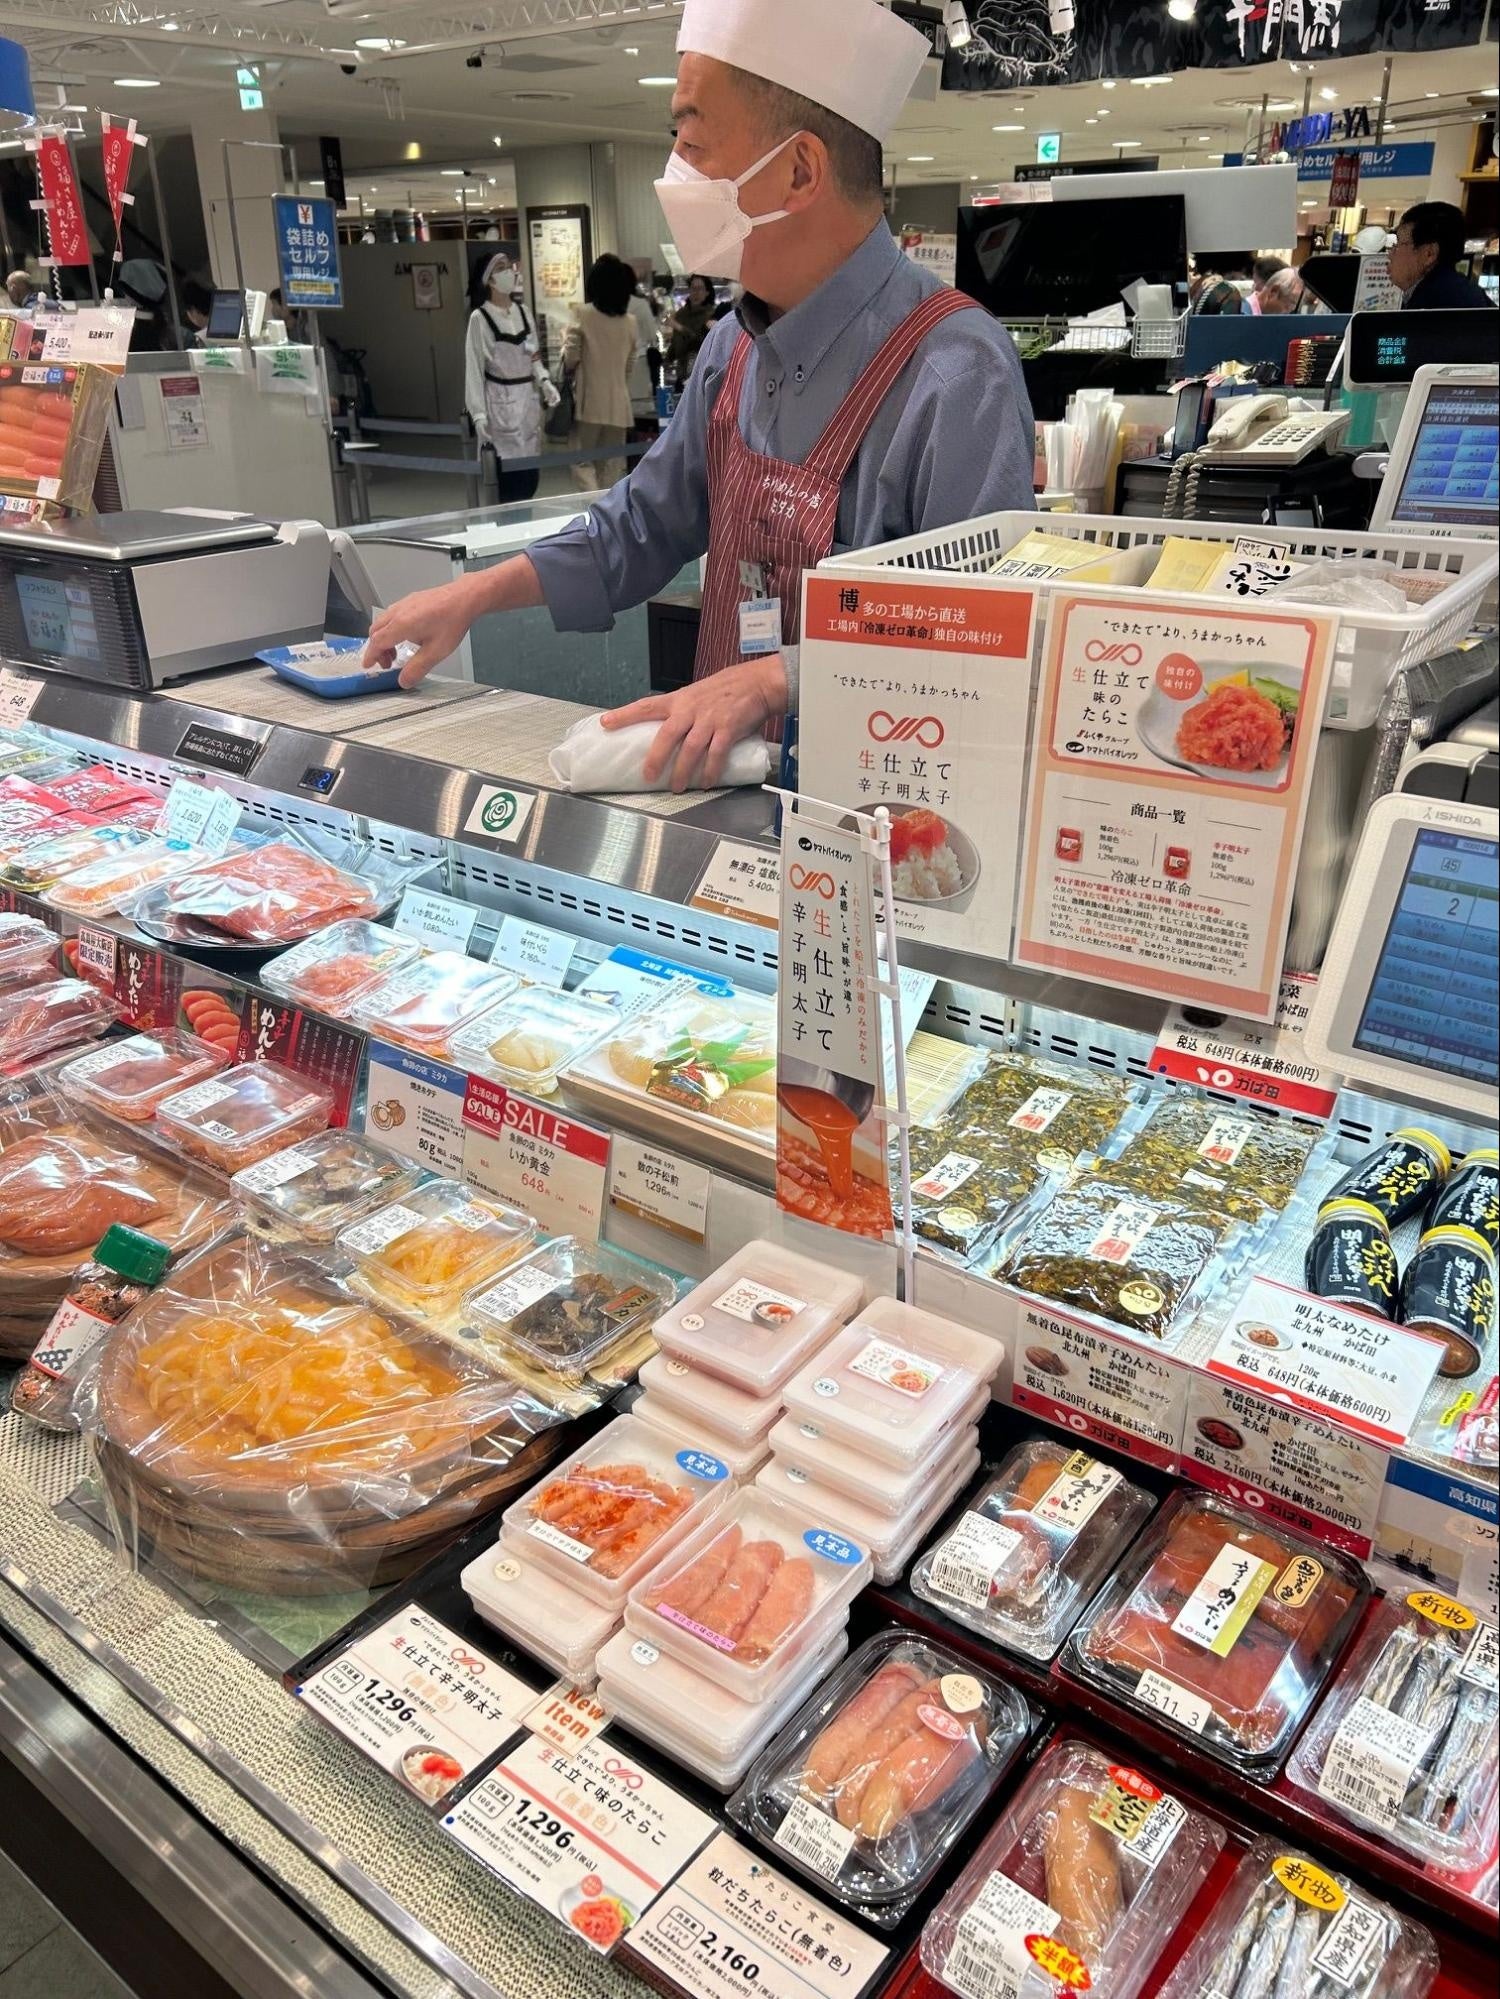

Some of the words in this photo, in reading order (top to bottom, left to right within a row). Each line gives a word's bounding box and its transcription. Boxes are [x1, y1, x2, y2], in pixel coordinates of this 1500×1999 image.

[286, 227, 329, 246] 袋詰め
[288, 248, 330, 264] セルフ
[839, 587, 967, 625] 博多の工場から直送
[827, 619, 1004, 646] 工場内「冷凍ゼロ革命」独自の味付け
[1072, 666, 1151, 689] 生仕立て
[1163, 679, 1194, 690] 味付け
[1165, 665, 1196, 677] 独自の
[1093, 692, 1122, 706] 味の
[1083, 707, 1128, 726] たらこ
[858, 750, 951, 780] 生仕立て
[858, 777, 950, 805] 辛子明太子
[1130, 802, 1187, 825] 商品一覧
[1435, 811, 1482, 827] ISHIDA
[813, 842, 853, 863] ヤマトバイオレッツ
[1213, 841, 1251, 855] 辛子明太子
[729, 859, 756, 875] 無漂白
[1443, 858, 1460, 872] 45
[1110, 869, 1192, 896] 冷凍ゼロ革命
[1447, 898, 1460, 916] 2
[79, 931, 113, 952] 高島屋大阪店
[79, 947, 113, 969] 限定販売
[791, 902, 808, 1041] 辛子明太子
[127, 952, 144, 1020] めんたい
[813, 907, 836, 1051] 生仕立て
[1278, 1002, 1309, 1019] かば田
[1176, 1034, 1198, 1052] 税込
[1205, 1044, 1320, 1083] 648円(本体価格600円)
[466, 1098, 502, 1123] SALE
[502, 1099, 570, 1150] SALE
[418, 1137, 436, 1156] 80g
[537, 1142, 556, 1158] ミタカ
[509, 1147, 552, 1177] いか黄金
[637, 1159, 680, 1188] 数の子松前
[1295, 1303, 1391, 1345] 明太なめたけ
[1025, 1312, 1170, 1379] 無着色昆布漬辛子めんたい
[1290, 1319, 1325, 1338] 北九州
[1343, 1337, 1377, 1358] かば田
[1062, 1341, 1091, 1361] 北九州
[1108, 1359, 1137, 1380] かば田
[1298, 1363, 1321, 1378] 120g
[1026, 1375, 1046, 1392] 税込
[1236, 1353, 1260, 1373] 税込
[1267, 1366, 1392, 1425] 648円(本体価格600円)
[1222, 1387, 1361, 1451] 無着色昆布漬辛子めんたい
[1240, 1418, 1270, 1436] 北九州
[1287, 1437, 1317, 1456] かば田
[682, 1453, 718, 1477] 見本品
[1194, 1446, 1216, 1465] 税込
[1223, 1460, 1362, 1531] 2,160円(本体価格2,000円)
[1449, 1487, 1498, 1516] 高知県
[810, 1533, 850, 1561] 見本品
[1417, 1594, 1468, 1625] 新物
[330, 1673, 347, 1689] 100g
[391, 1636, 503, 1723] 生仕立て辛子明太子
[564, 1687, 606, 1722] New
[1138, 1683, 1179, 1718] 25.11.
[1187, 1708, 1200, 1727] 3
[544, 1701, 591, 1739] Item
[486, 1781, 509, 1802] 内容量
[1117, 1768, 1154, 1796] 無着色
[476, 1794, 498, 1813] 100g
[537, 1748, 667, 1845] 生仕立て味のたらこ
[1136, 1798, 1177, 1852] 北海道産
[822, 1856, 840, 1871] 2160
[1279, 1863, 1337, 1905] 新物
[707, 1865, 853, 1977] 粒だちたらこ(無着色)
[764, 1881, 836, 1936] たらこ食堂
[1325, 1907, 1376, 1970] 高知県産
